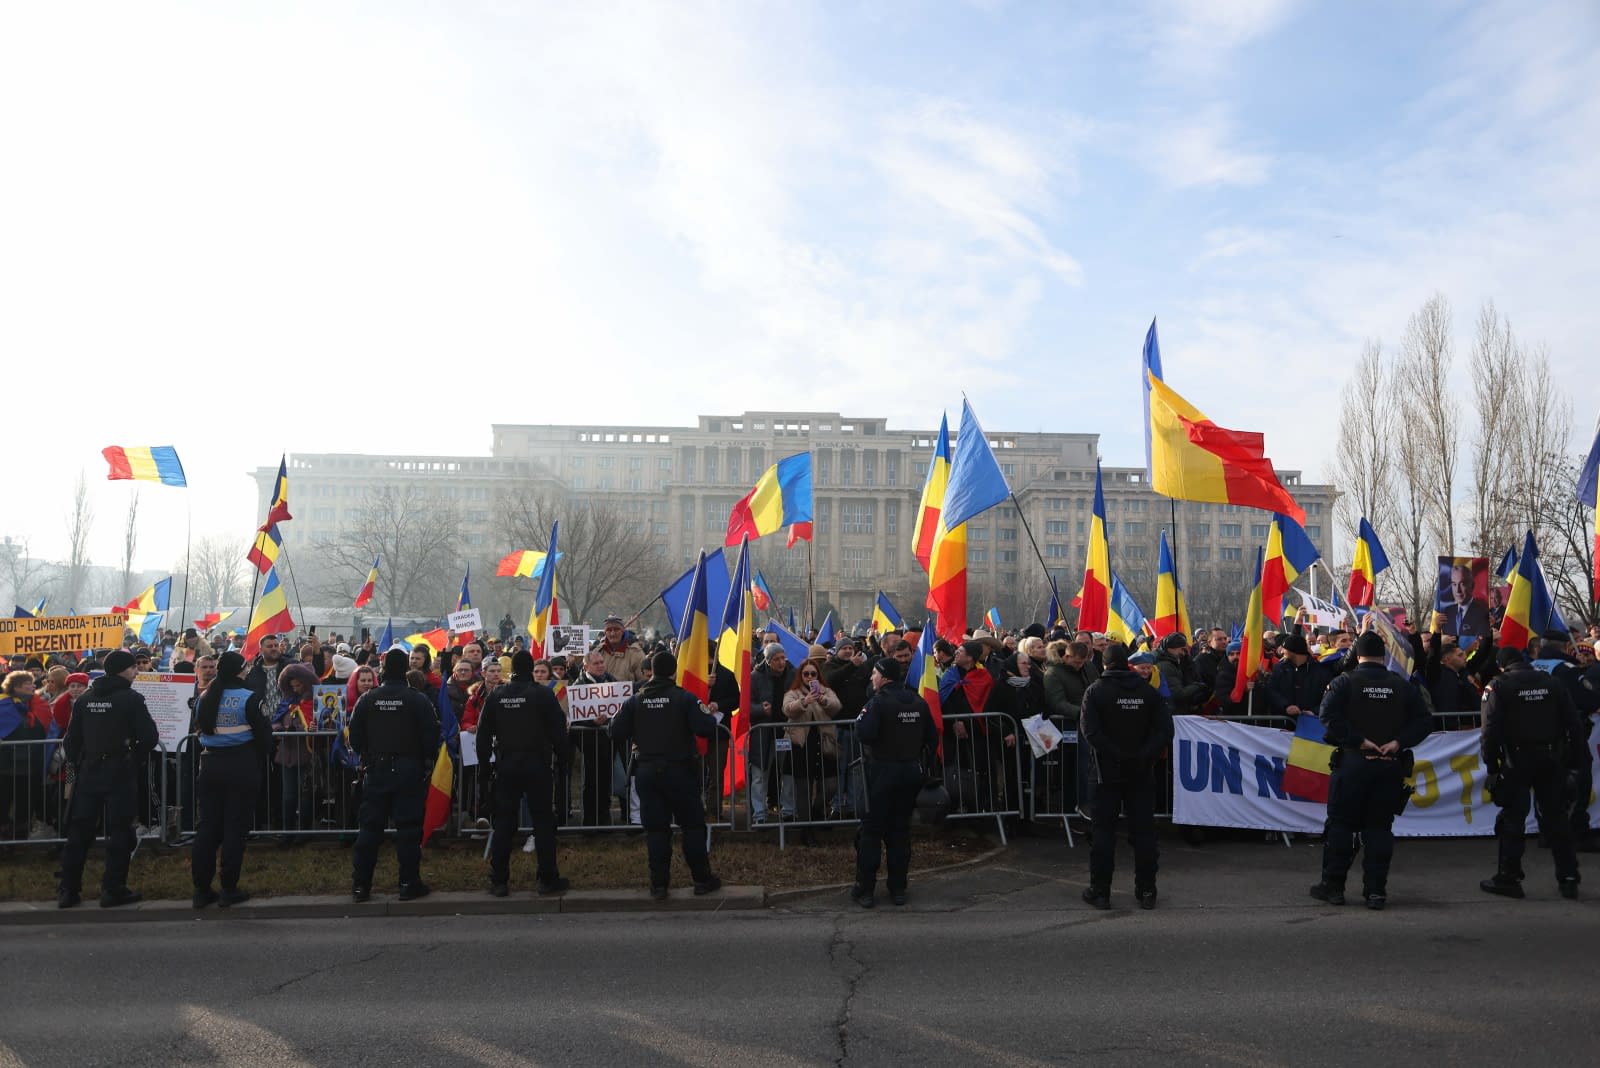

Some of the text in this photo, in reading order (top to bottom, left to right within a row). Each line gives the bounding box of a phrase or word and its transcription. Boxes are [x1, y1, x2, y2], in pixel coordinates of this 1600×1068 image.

[92, 615, 123, 628] ITALIA
[569, 684, 632, 701] TURUL 2
[1178, 739, 1243, 796] UN
